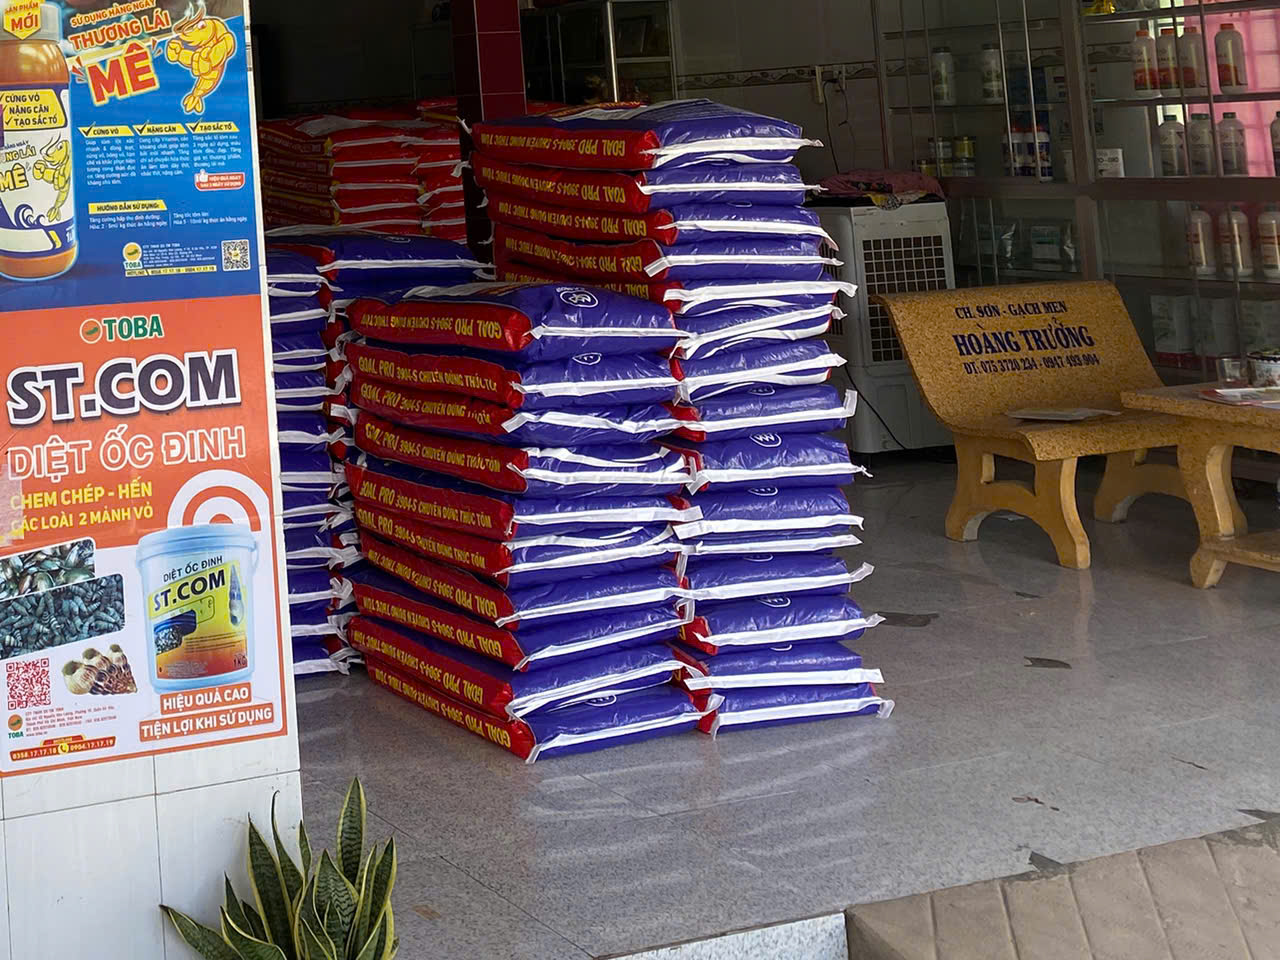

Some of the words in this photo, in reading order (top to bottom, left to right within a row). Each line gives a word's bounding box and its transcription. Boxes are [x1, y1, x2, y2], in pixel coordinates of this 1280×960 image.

[11, 12, 39, 32] MỚI
[70, 19, 143, 51] THƯƠNG
[143, 9, 172, 32] LÁI
[87, 41, 157, 104] MÊ
[578, 139, 598, 156] PRO
[602, 139, 625, 157] GOAL
[976, 304, 1000, 318] SƠN
[1009, 302, 1041, 320] GẠCH
[1043, 300, 1067, 313] MEN
[102, 315, 164, 341] TOBA
[953, 323, 1020, 356] HOÀNG
[1019, 317, 1095, 352] TRƯỞNG
[359, 356, 377, 372] GOAL
[379, 358, 394, 377] PRO
[7, 349, 240, 426] ST.COM
[9, 440, 92, 483] DIỆT
[100, 424, 153, 471] ỐC
[162, 426, 246, 465] ĐINH
[61, 484, 105, 505] CHÉP
[118, 476, 152, 499] HẾN
[41, 511, 73, 529] LOÀI
[79, 512, 87, 525] 2
[90, 506, 131, 524] MẢNH
[133, 502, 153, 519] VỎ
[153, 569, 225, 611] ST.COM
[456, 629, 474, 648] PRO
[477, 635, 502, 657] GOAL
[163, 694, 192, 711] HIỆU
[196, 688, 221, 704] QUẢ
[224, 687, 248, 701] CAO
[141, 722, 170, 739] TIỆN
[174, 719, 193, 734] LỢI
[196, 716, 216, 729] KHI
[220, 710, 237, 726] SỬ
[238, 708, 272, 726] DỤNG
